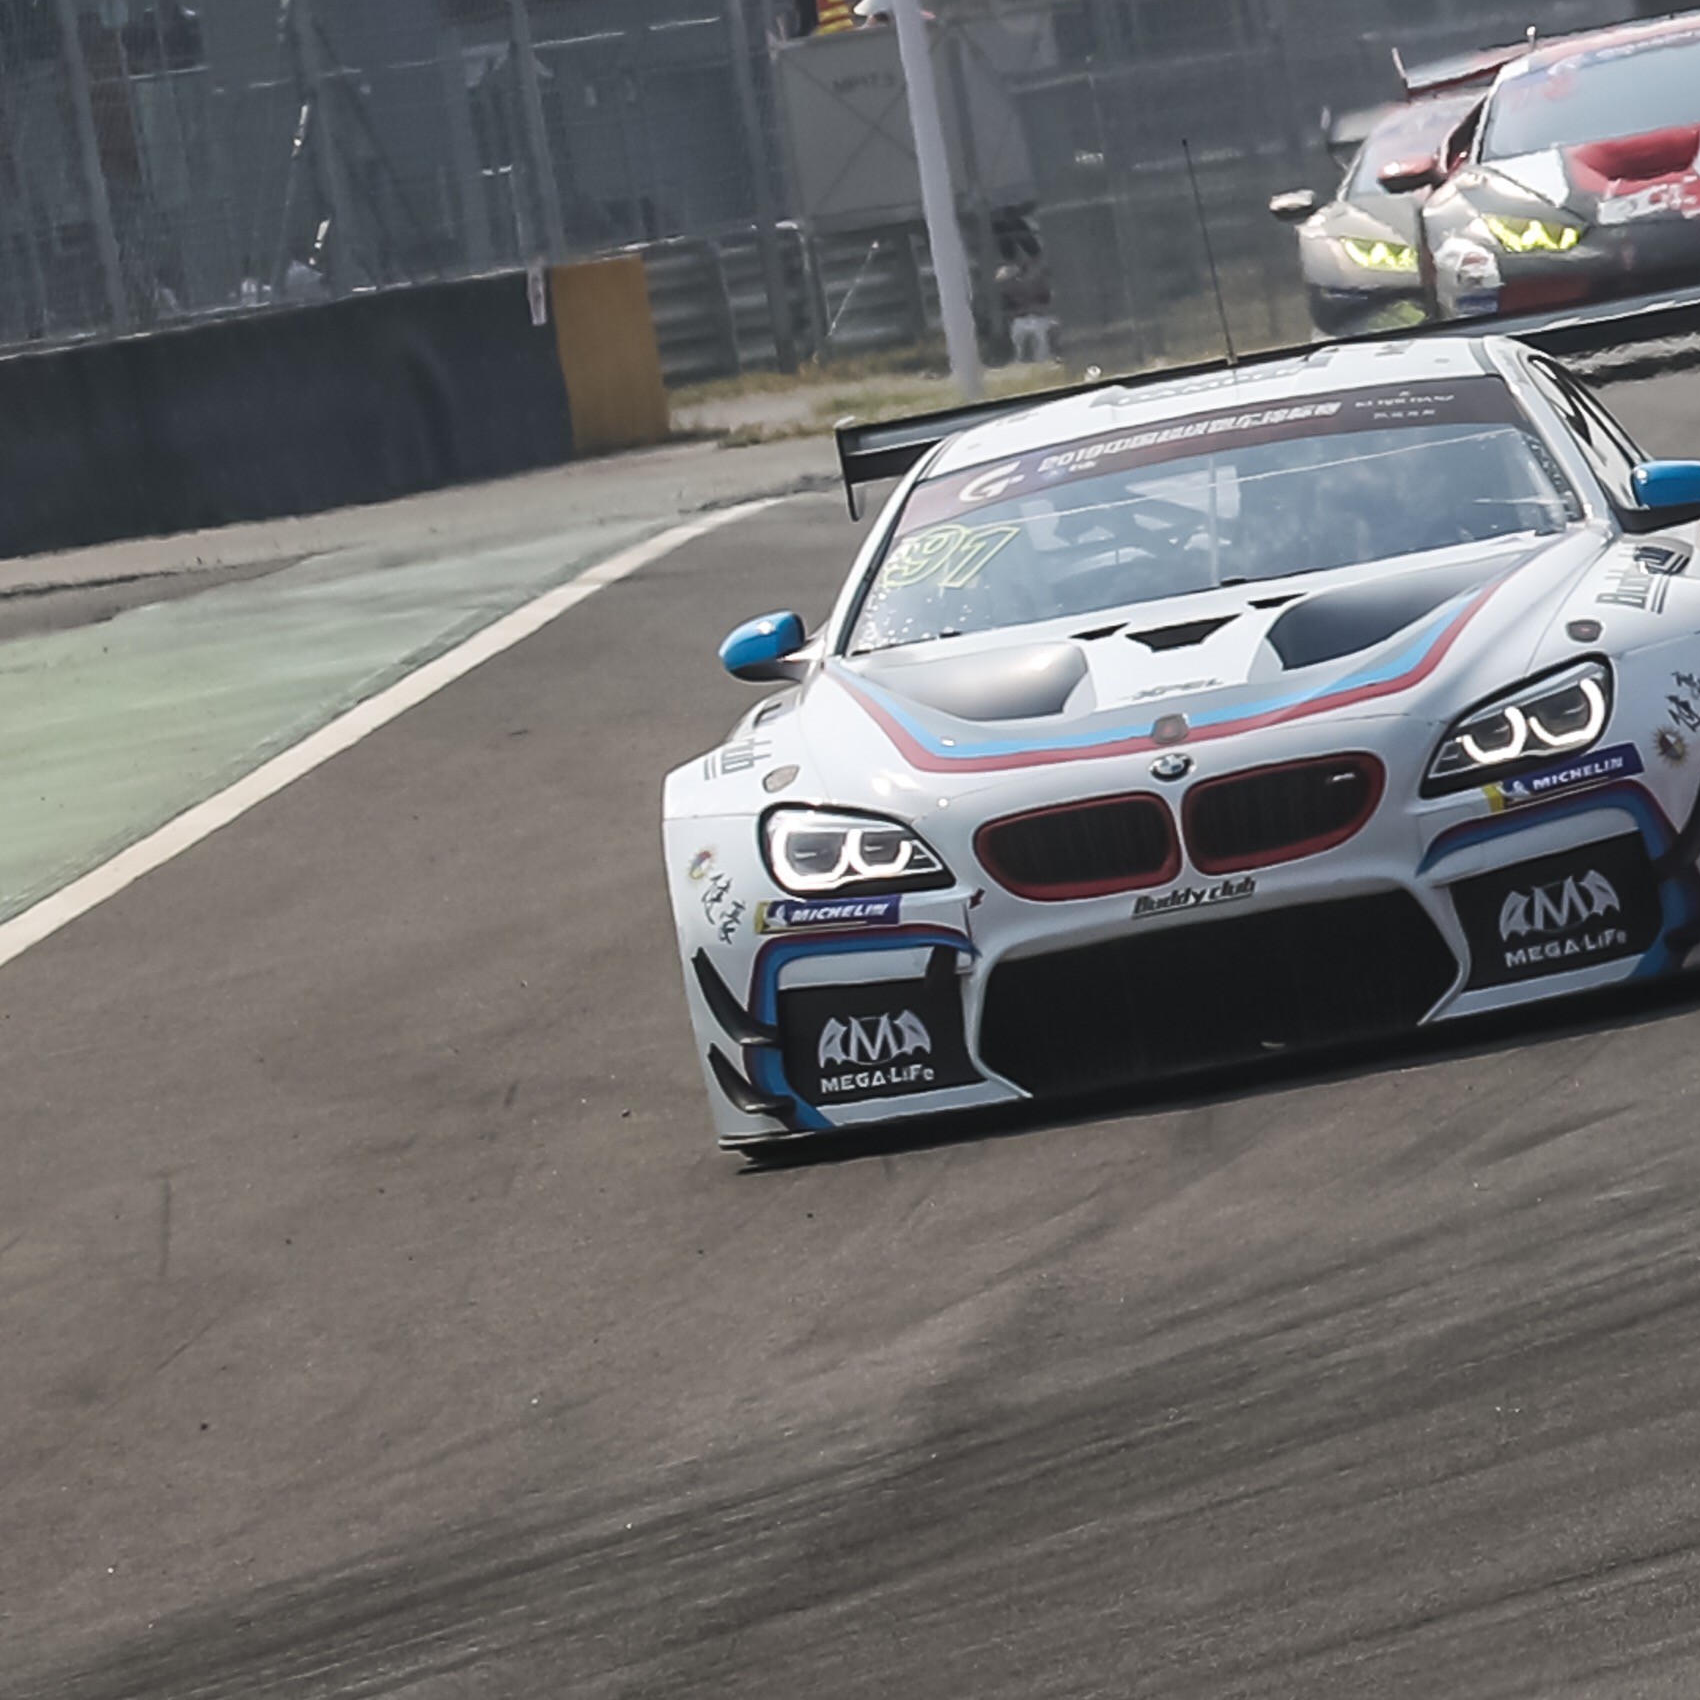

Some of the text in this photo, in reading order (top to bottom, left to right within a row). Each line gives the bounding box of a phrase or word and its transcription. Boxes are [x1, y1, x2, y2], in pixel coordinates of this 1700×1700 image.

[882, 522, 1021, 590] 91
[1531, 755, 1625, 792] MICHELIN
[790, 901, 891, 924] MICHELIN
